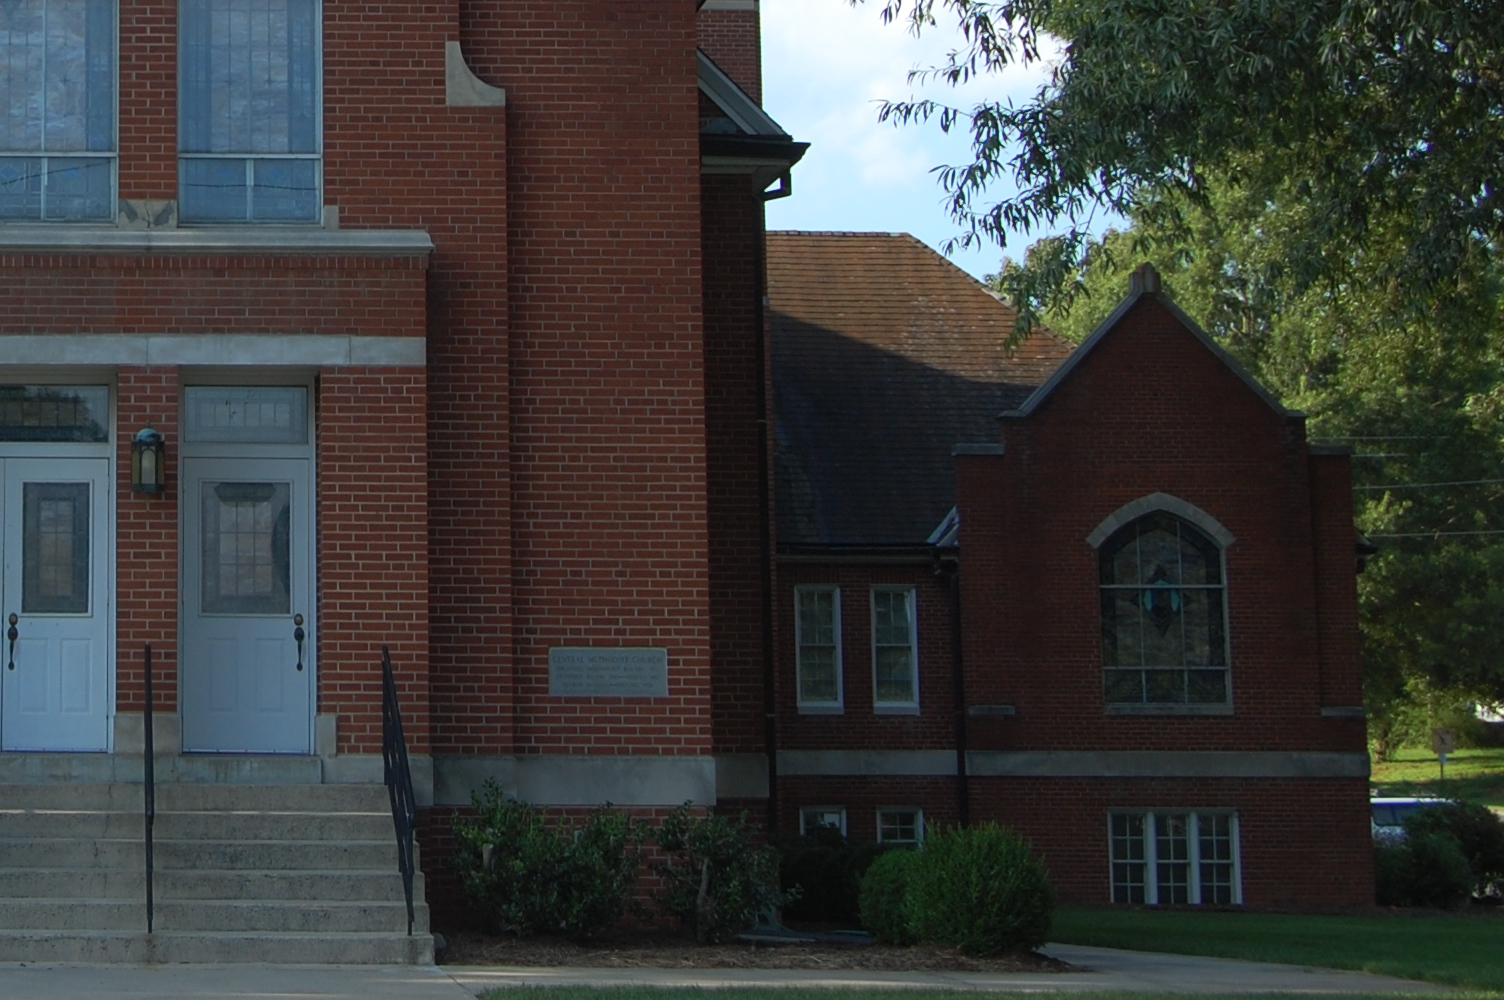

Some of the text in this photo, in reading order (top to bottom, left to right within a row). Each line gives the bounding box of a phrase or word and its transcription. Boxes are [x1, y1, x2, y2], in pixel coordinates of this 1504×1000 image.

[552, 655, 663, 663] CENTRAL METHODIST CHURCH
